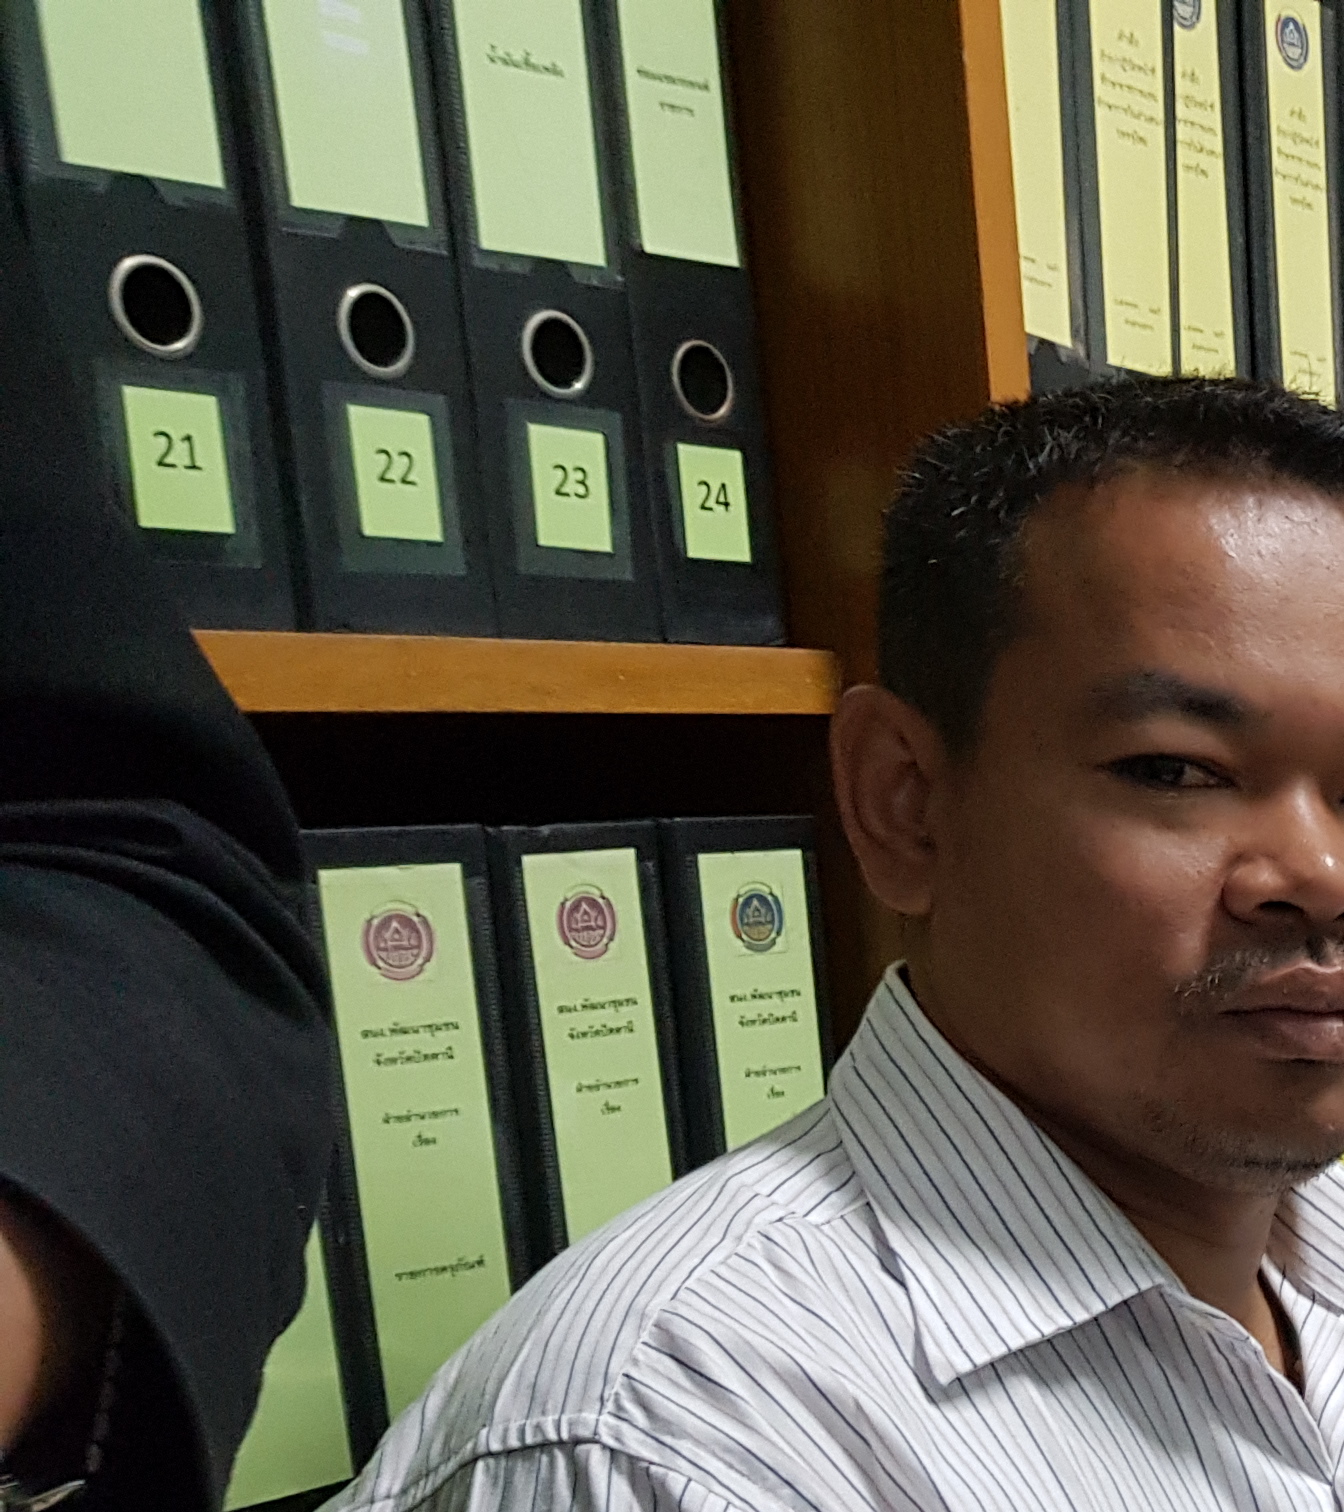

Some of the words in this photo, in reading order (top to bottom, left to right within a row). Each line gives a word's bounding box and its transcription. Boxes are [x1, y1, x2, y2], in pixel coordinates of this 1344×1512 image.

[153, 430, 203, 472] 21
[375, 449, 418, 487] 22
[553, 465, 592, 500] 23
[697, 481, 731, 513] 24
